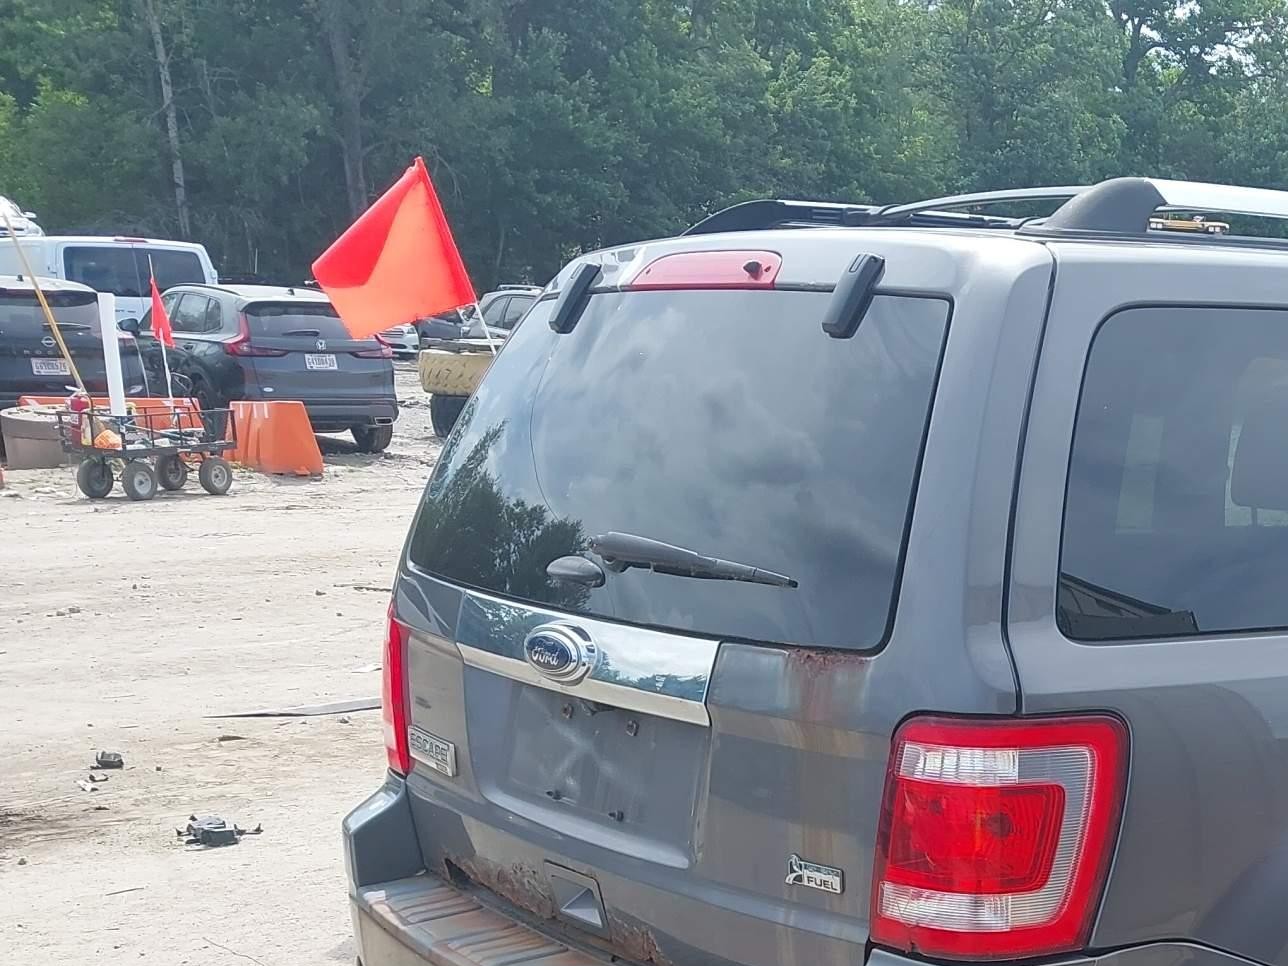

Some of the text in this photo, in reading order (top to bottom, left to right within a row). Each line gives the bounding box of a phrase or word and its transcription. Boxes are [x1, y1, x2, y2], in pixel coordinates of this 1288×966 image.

[532, 638, 561, 666] Ford
[411, 732, 448, 763] ESCAPE
[807, 876, 838, 891] FUEL
